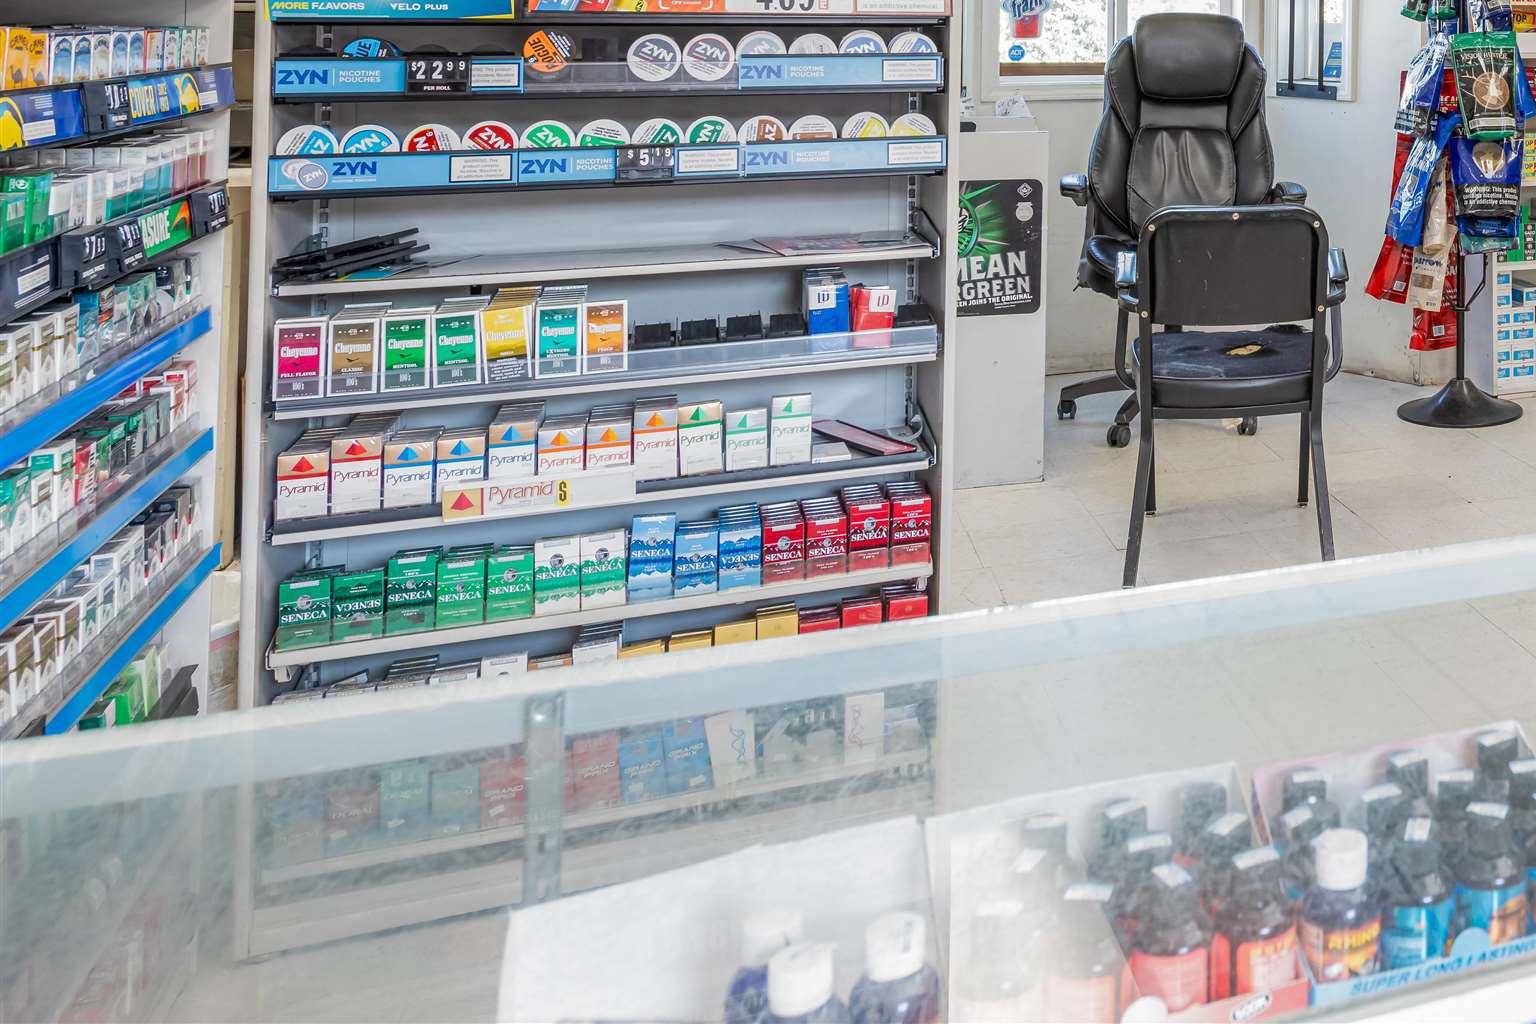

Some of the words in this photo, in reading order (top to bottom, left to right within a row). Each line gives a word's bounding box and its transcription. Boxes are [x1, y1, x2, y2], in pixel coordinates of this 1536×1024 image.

[271, 2, 309, 10] MORE
[311, 1, 365, 10] FLAVORS
[277, 70, 329, 85] ZYN
[741, 64, 782, 79] ZYN
[332, 161, 377, 176] ZYN
[521, 159, 567, 174] ZYN
[1001, 294, 1033, 302] ORIGINAL.
[335, 341, 371, 355] Cheyenne
[388, 337, 423, 350] Cheyenne
[280, 345, 318, 359] Cheyenne
[489, 451, 532, 466] Pyramid
[334, 466, 379, 482] Pyramid
[385, 470, 431, 485] Pyramid
[438, 464, 482, 480] Pyramid
[279, 482, 326, 497] Pyramid
[488, 480, 554, 503] Pyramid
[631, 548, 671, 559] SENECA
[388, 589, 433, 603] SENECA
[438, 589, 482, 604] SENECA
[281, 608, 328, 624] SENECA
[1350, 971, 1411, 996] SUPER
[1467, 939, 1536, 969] LASTING
